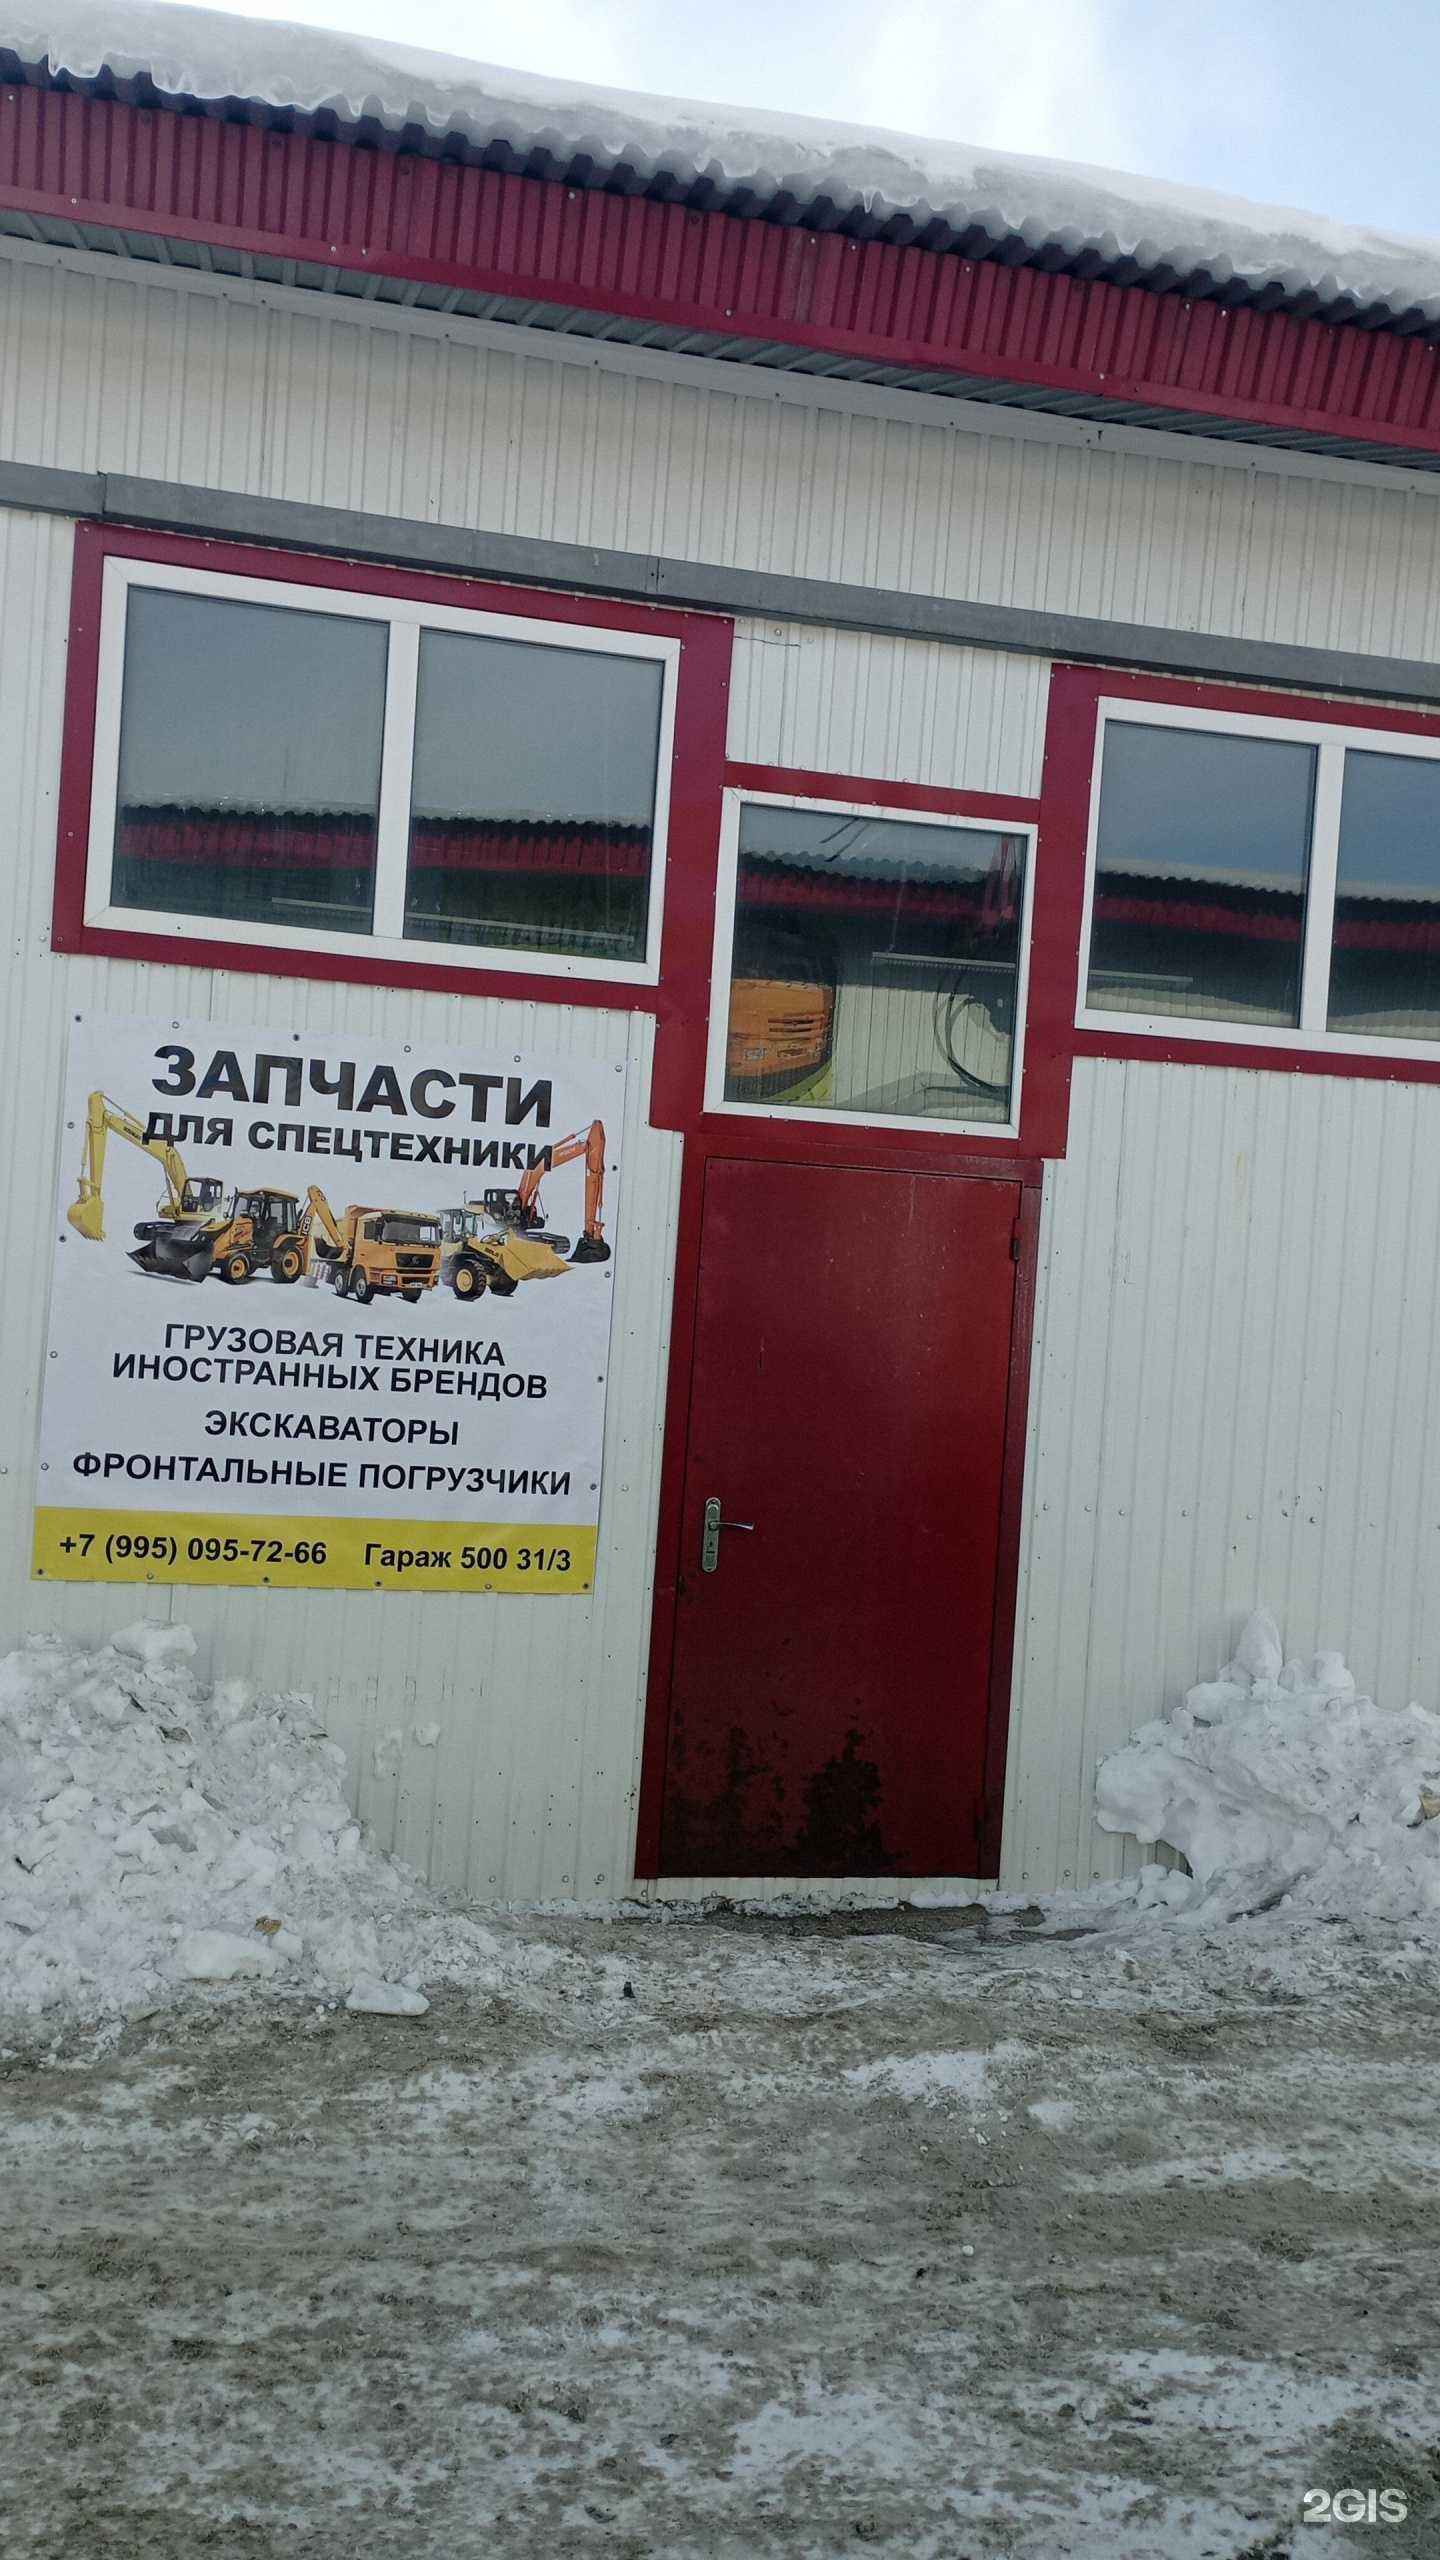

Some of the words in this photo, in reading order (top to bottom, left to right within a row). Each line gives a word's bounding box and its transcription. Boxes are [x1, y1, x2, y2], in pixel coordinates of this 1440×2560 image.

[151, 1045, 553, 1128] ЗАПЧАСТИ
[141, 1111, 234, 1147] ДЛЯ
[248, 1121, 554, 1172] СПЕЦТЕХНИКИ
[164, 1323, 344, 1358] ГРУЗОВАЯ
[354, 1334, 506, 1367] ТЕХНИКА
[112, 1352, 381, 1392] ИНОСТРАННЫХ
[389, 1367, 548, 1402] БРЕНДОВ
[204, 1409, 460, 1446] ЭКСКАВАТОРЫ
[73, 1451, 349, 1488] ФРОНТАЛЬНЫЕ
[358, 1463, 572, 1496] ПОГРУЗЧИКИ
[58, 1533, 96, 1557] +7
[105, 1533, 179, 1566] (995)
[186, 1537, 328, 1565] 095-72-66
[364, 1542, 453, 1573] Гараж
[459, 1546, 508, 1571] 500
[515, 1548, 572, 1572] 31/3
